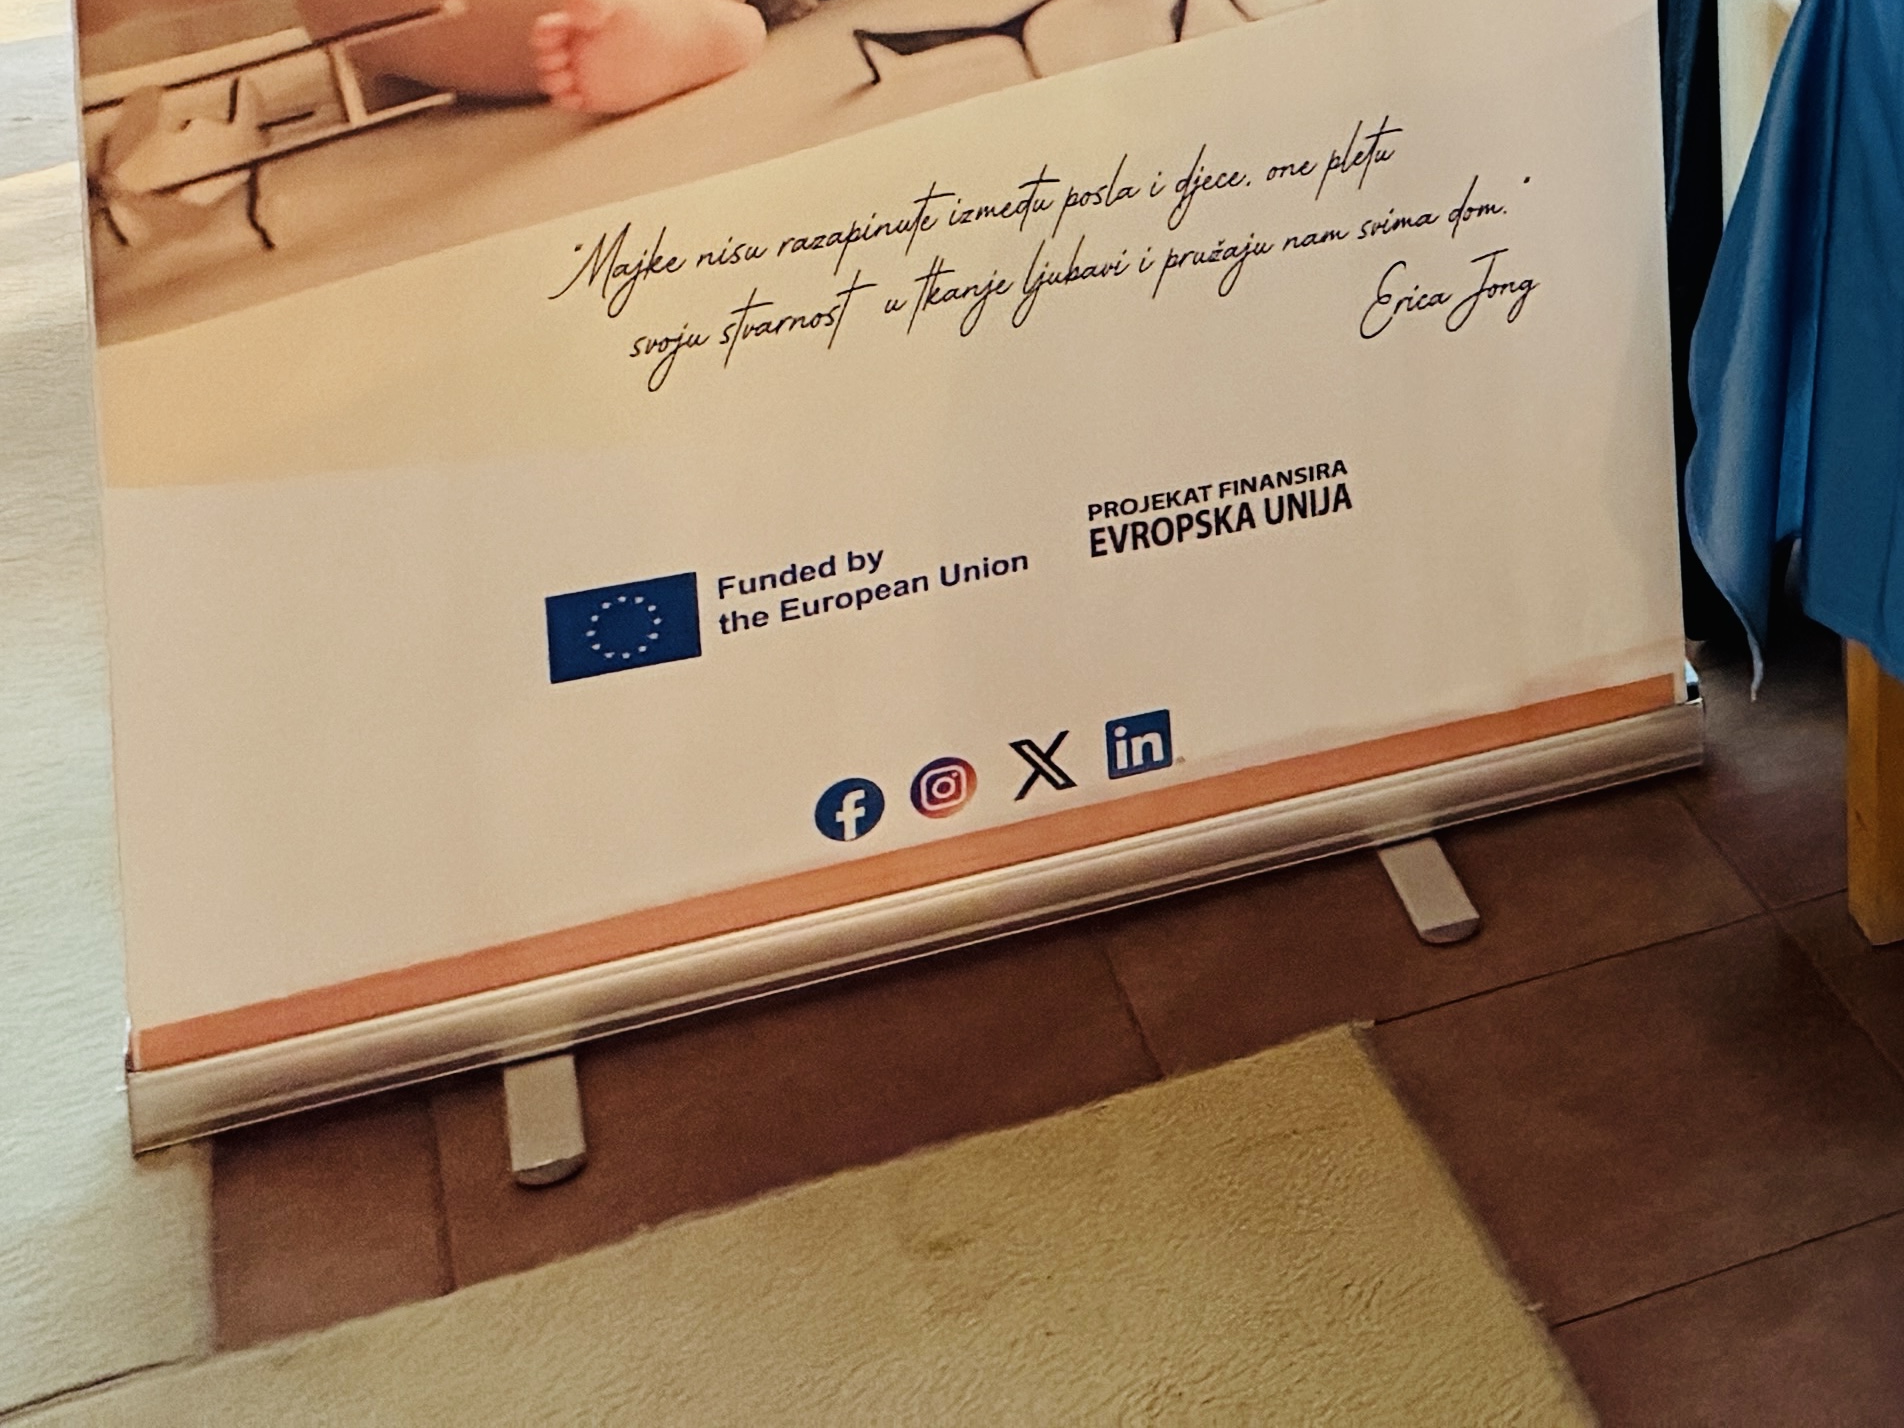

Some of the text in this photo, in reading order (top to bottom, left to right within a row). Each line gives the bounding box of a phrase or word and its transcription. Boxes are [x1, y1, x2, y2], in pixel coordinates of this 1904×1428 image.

[696, 235, 768, 270] nisu
[777, 181, 956, 276] razapinute
[1051, 153, 1142, 239] posla
[1149, 170, 1166, 198] i
[1266, 160, 1319, 182] one
[1315, 114, 1404, 201] pletu
[629, 322, 711, 392] svoju
[719, 269, 878, 368] stvarnost
[884, 293, 908, 317] u
[906, 255, 1016, 338] tkanje
[1011, 234, 1132, 328] ljubavi
[1139, 244, 1156, 272] i
[1152, 238, 1277, 299] pružaju
[1282, 229, 1352, 252] nam
[1357, 208, 1440, 241] svima
[1360, 248, 1541, 340] Erica Jong
[1087, 459, 1349, 522] PROJEKAT FINANSIRA
[1089, 482, 1354, 559] EVROPSKA UNIJA
[717, 549, 885, 600] Funded by
[718, 553, 1030, 635] the European Union
